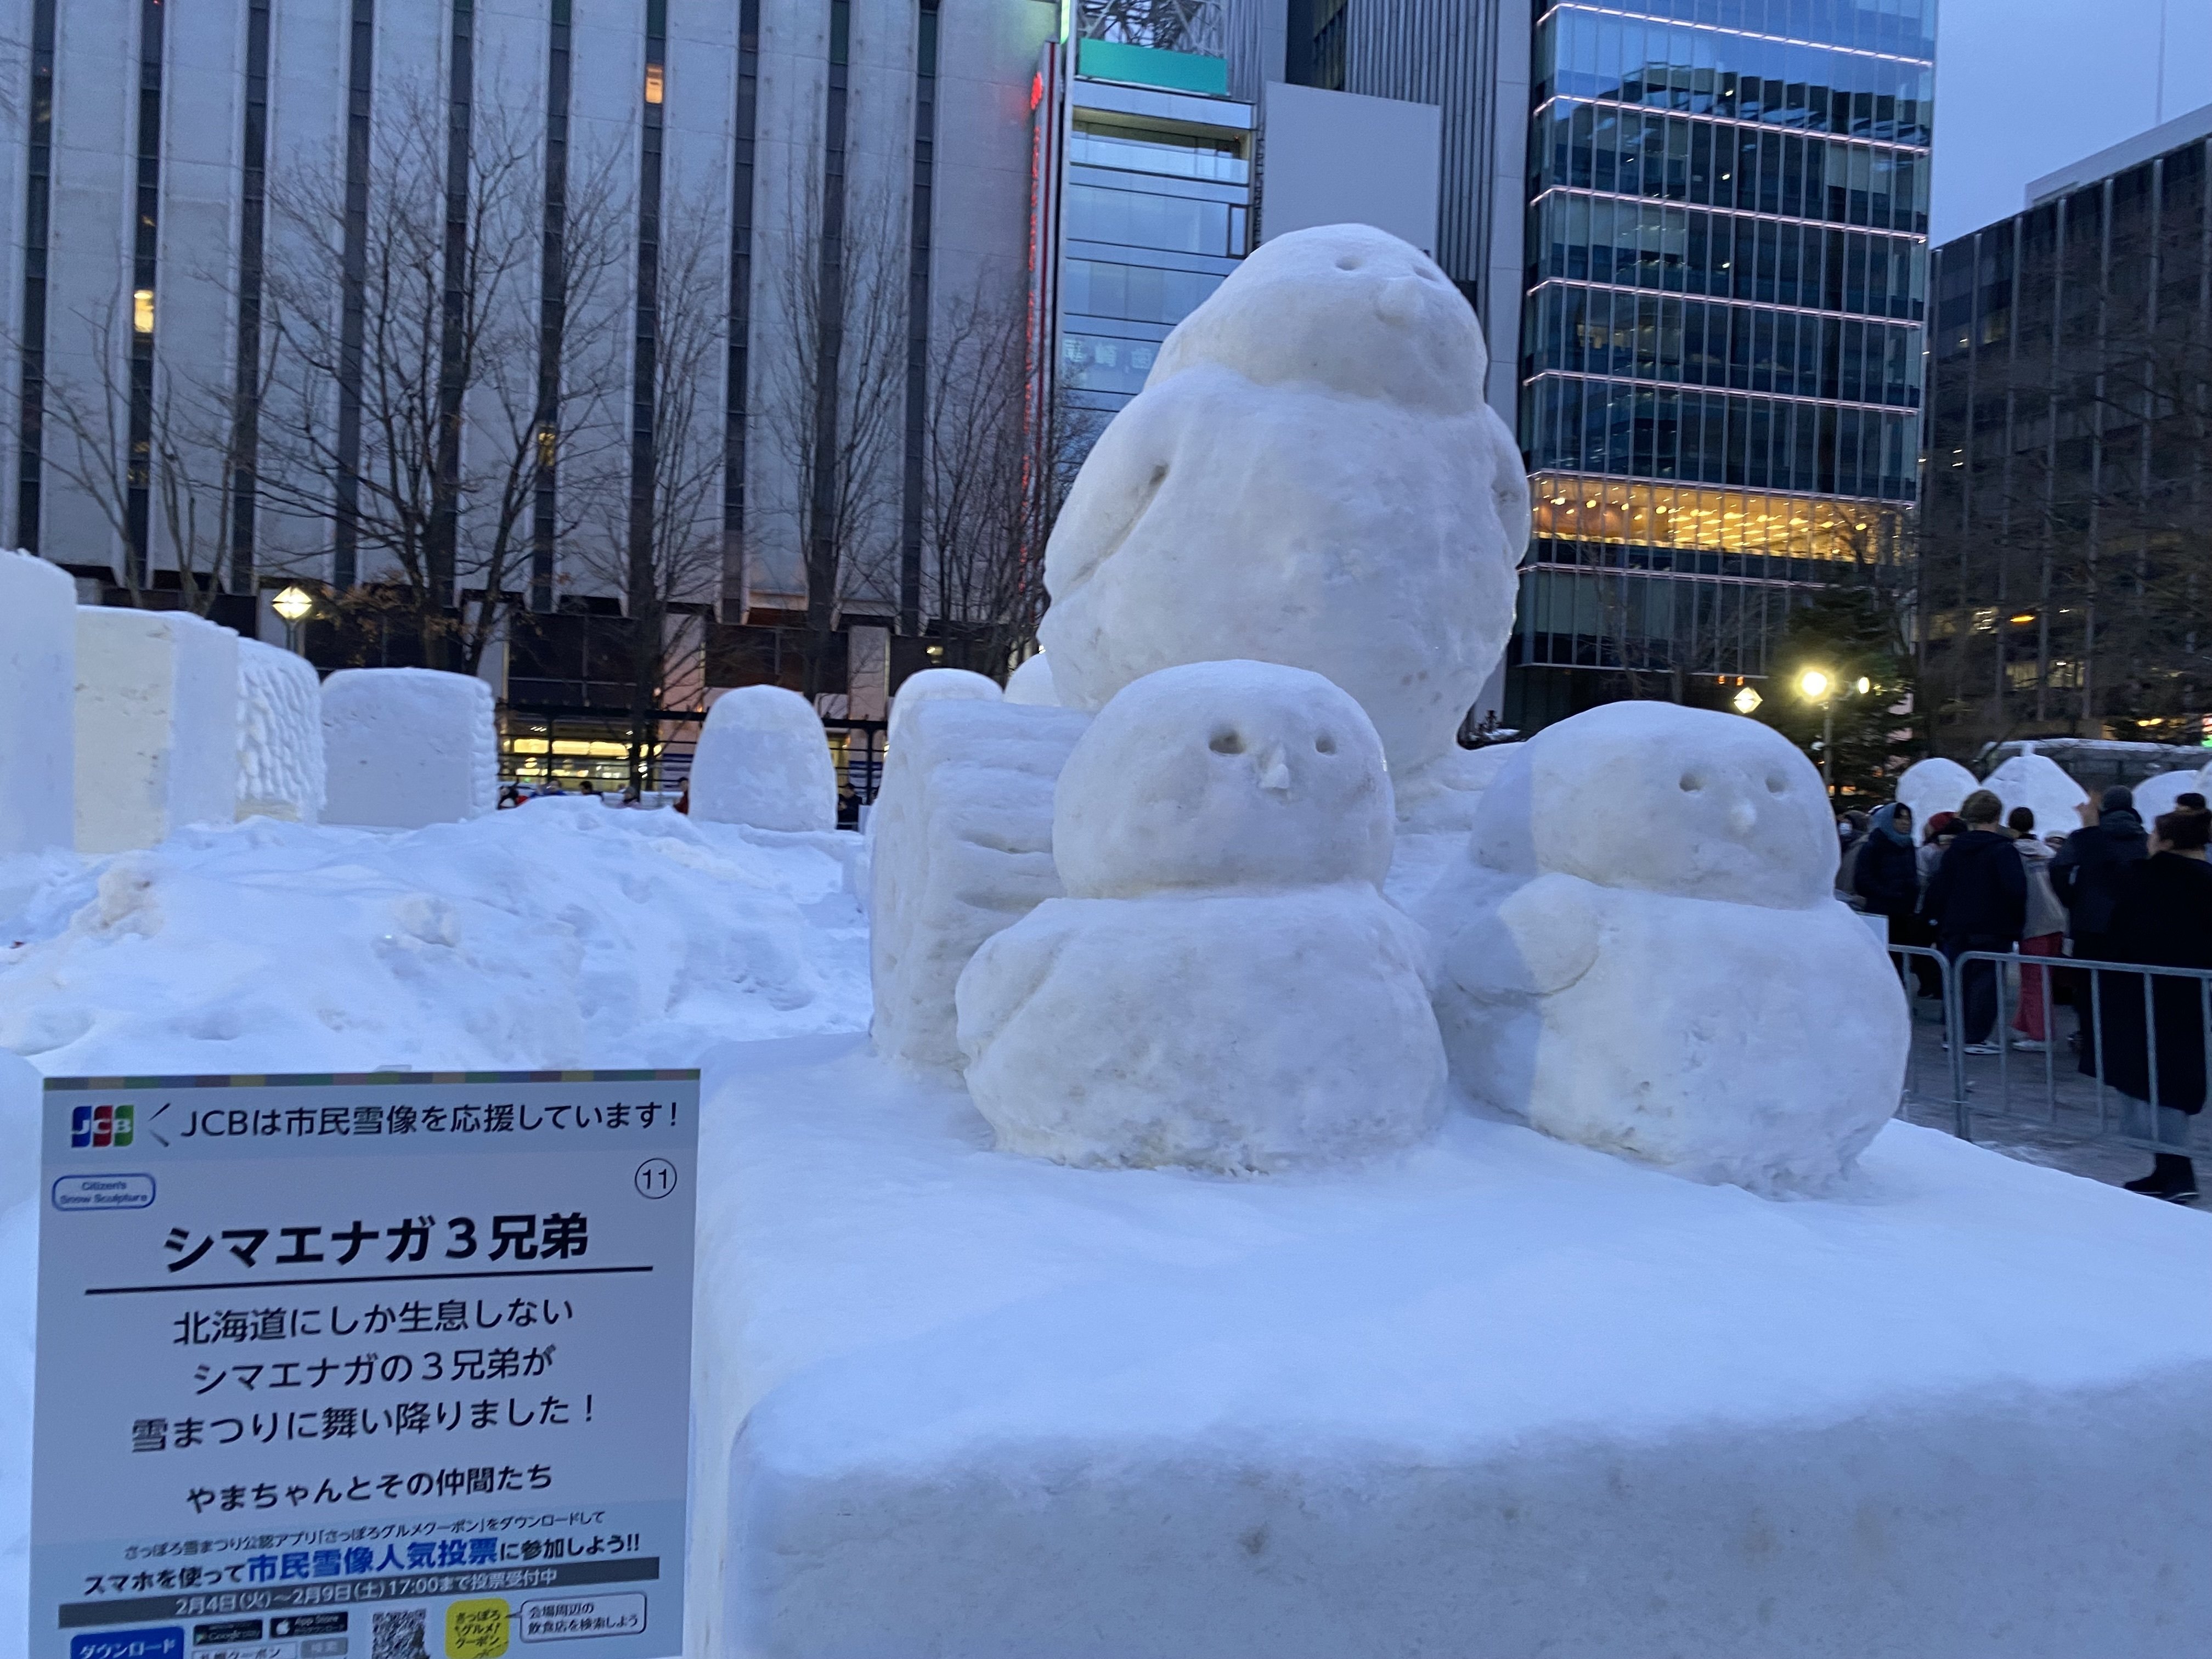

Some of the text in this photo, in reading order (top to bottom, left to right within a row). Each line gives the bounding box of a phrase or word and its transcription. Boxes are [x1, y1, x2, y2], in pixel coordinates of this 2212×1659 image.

[181, 1102, 677, 1137] JCBは市民雪像を応援しています!
[60, 1193, 147, 1206] Snow Sculpture
[82, 1181, 127, 1190] Citizen's
[164, 1211, 589, 1273] シマエナガ3兄弟
[173, 1298, 573, 1345] 北海道にしか生息しない
[193, 1344, 556, 1395] シマエナガの3兄弟が
[131, 1395, 594, 1453] 雪まつりに舞い降りました!
[186, 1463, 552, 1514] やまちゃんとその仲間たち
[125, 1510, 606, 1561] さっぽろ雪まつり公認アプリ「さっぽろグルメクーポン」をダウンロードして
[84, 1533, 640, 1596] スマホを使って市民雪像人気投票に参加しよう!!
